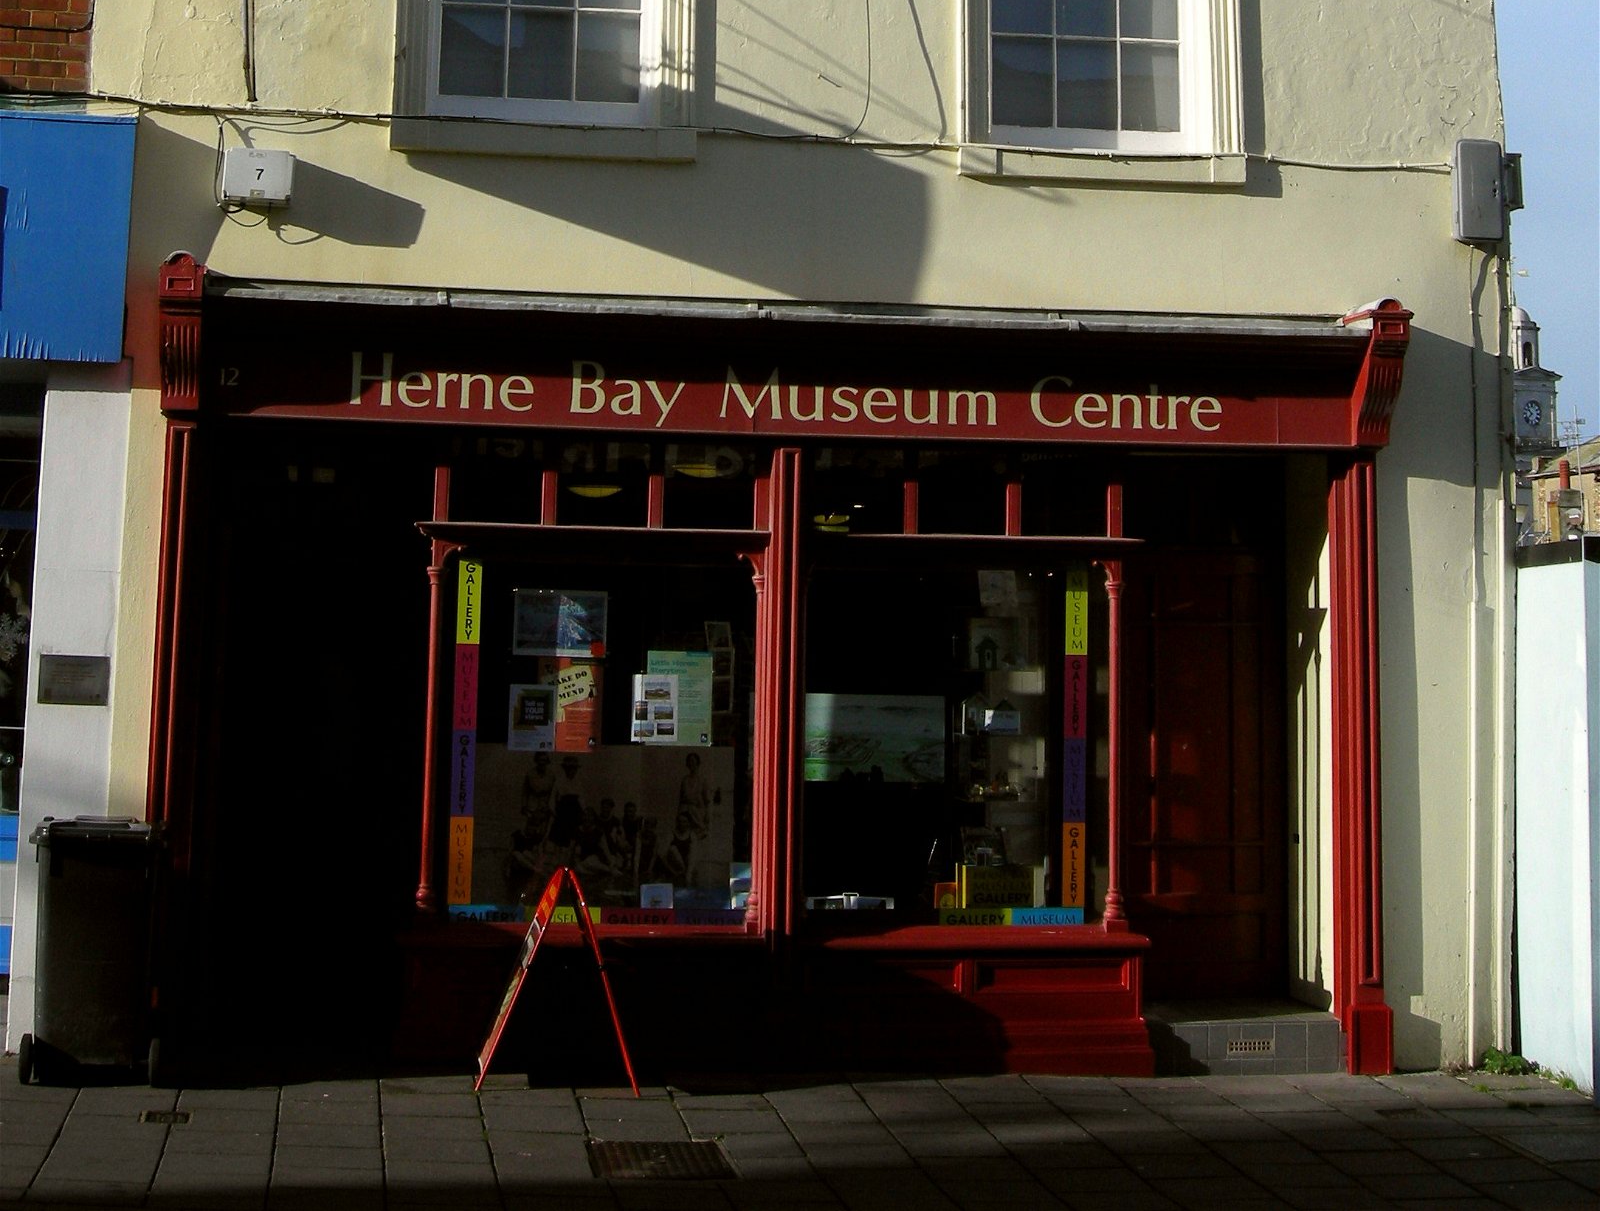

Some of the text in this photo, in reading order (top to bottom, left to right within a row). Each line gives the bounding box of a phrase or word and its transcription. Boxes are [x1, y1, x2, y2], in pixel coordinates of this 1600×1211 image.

[255, 168, 264, 180] 7
[220, 367, 240, 386] 12
[349, 350, 1224, 432] Herne Bay Museum Centre
[465, 563, 476, 640] GALLERY
[1071, 576, 1083, 650] MUSEUM
[462, 653, 473, 727] MUSEUM
[558, 687, 584, 699] MEND
[575, 671, 587, 680] DO
[1071, 659, 1081, 735] GALLERY
[459, 735, 470, 814] GALLERY
[1070, 746, 1081, 818] MUSEUM
[455, 824, 467, 899] MUSEUM
[974, 892, 1030, 904] GALLERY
[1069, 827, 1079, 904] GALLERY
[457, 911, 518, 923] GALLERY
[608, 913, 668, 924] GALLERY
[946, 913, 1076, 925] GALLERY MUSEUM
